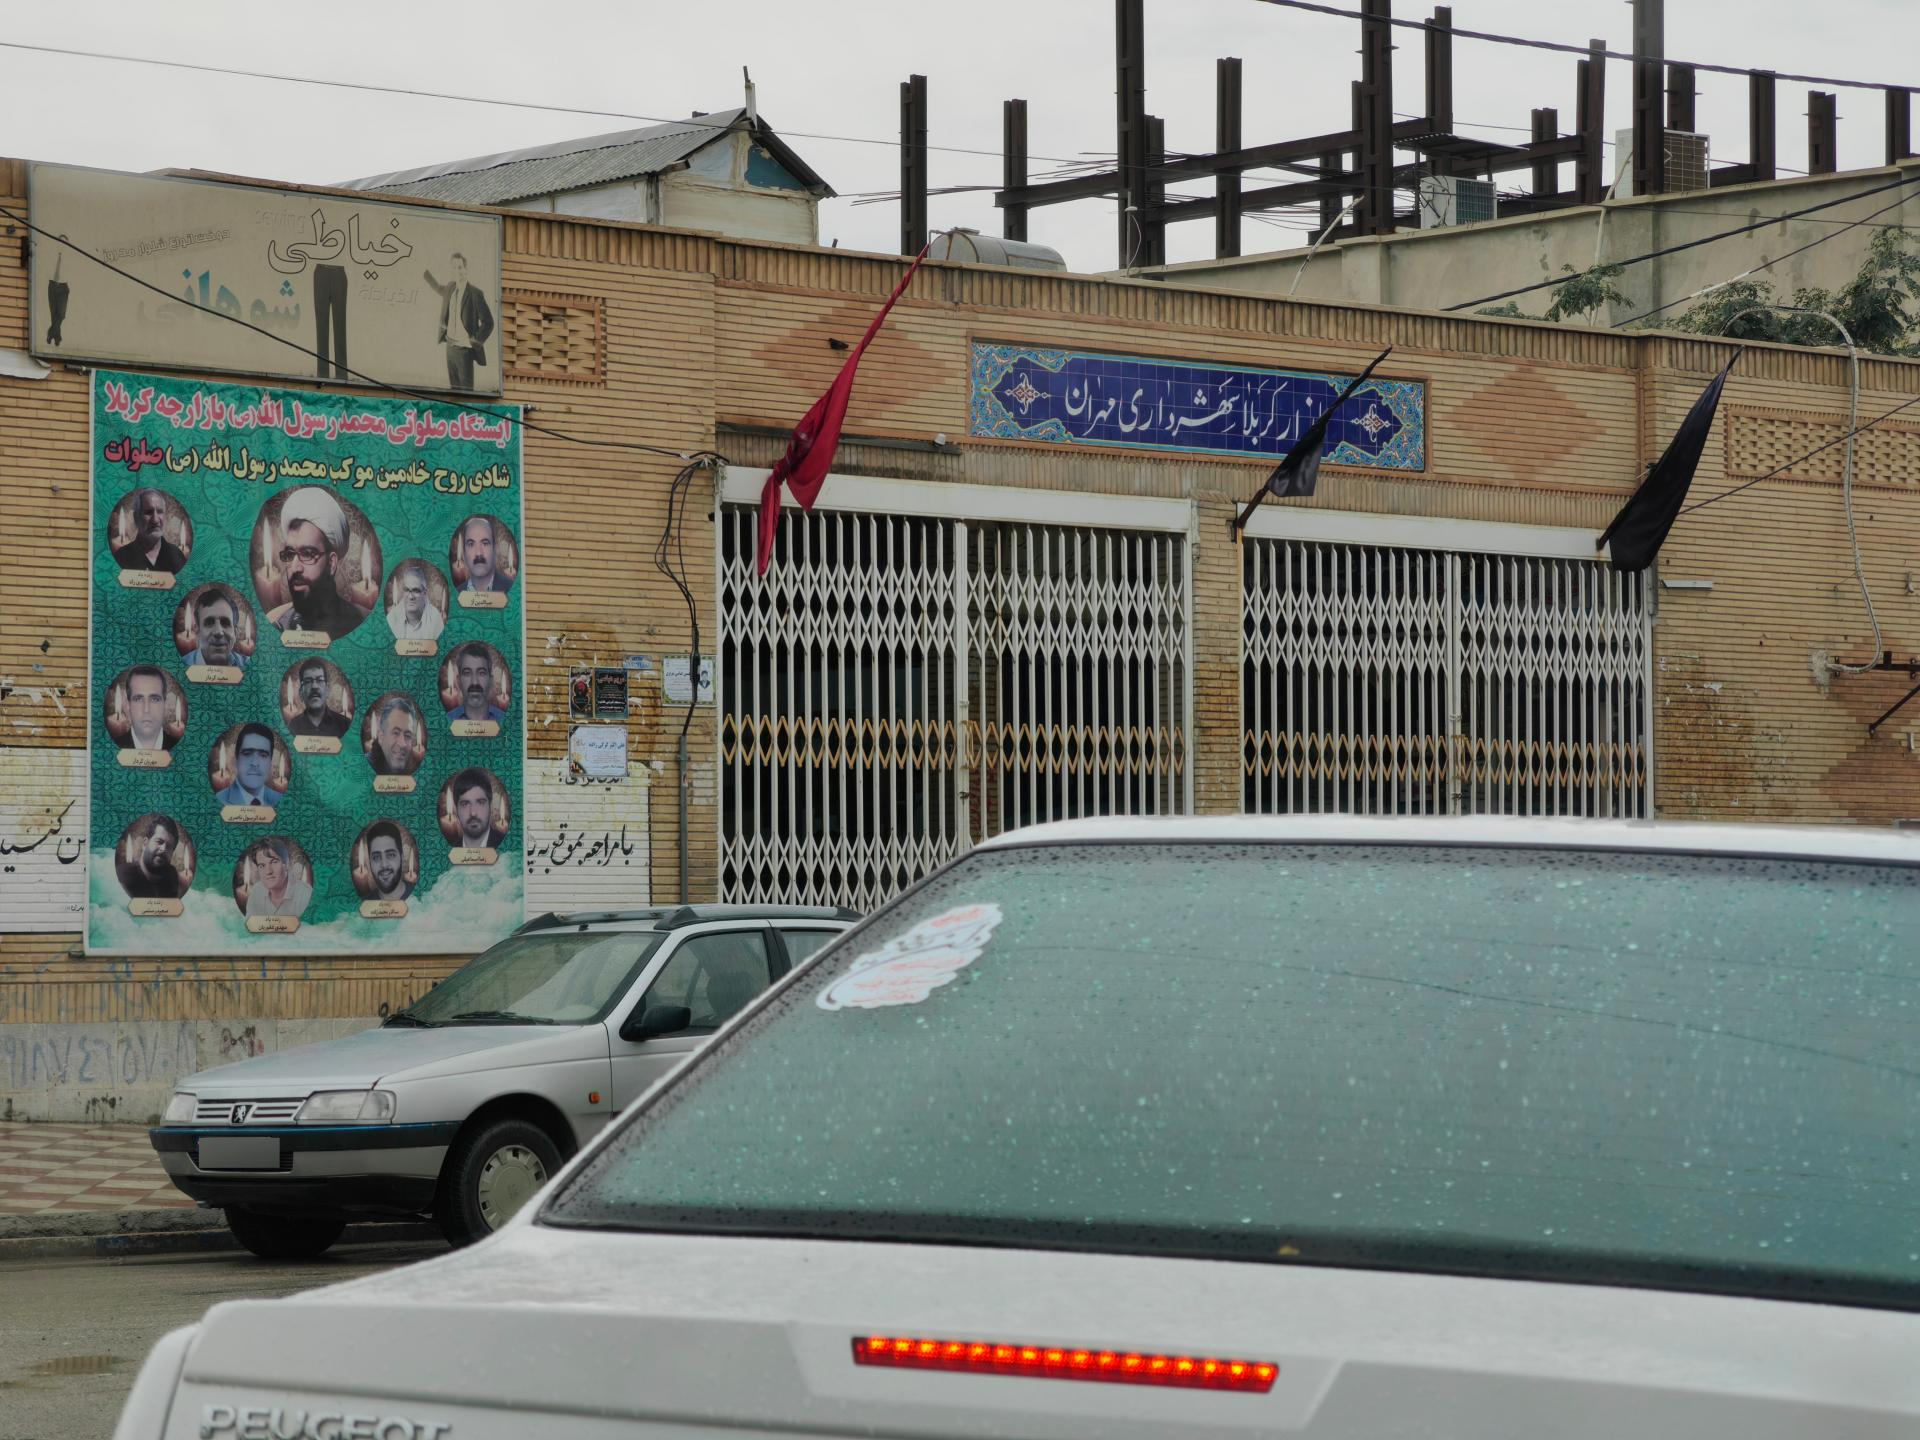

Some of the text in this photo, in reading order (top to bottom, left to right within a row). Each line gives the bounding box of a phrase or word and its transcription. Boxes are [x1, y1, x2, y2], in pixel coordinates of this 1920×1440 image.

[268, 208, 413, 280] خیاطی
[104, 380, 155, 424] کربلا
[154, 390, 227, 430] بازارچه
[283, 400, 339, 441] رسول
[338, 409, 387, 436] محمد
[1064, 375, 1117, 437] مهران
[1118, 377, 1240, 437] شهرداری
[1242, 380, 1289, 446] کربلا
[386, 407, 450, 447] صلواتی
[449, 411, 512, 449] ایستگاه
[103, 435, 511, 495] شادی روح خادمین موکب محمد رسول الله (ص) صلوات
[583, 832, 620, 867] مراجعه
[620, 823, 634, 866] با
[200, 1404, 452, 1440] PEUGEOT
